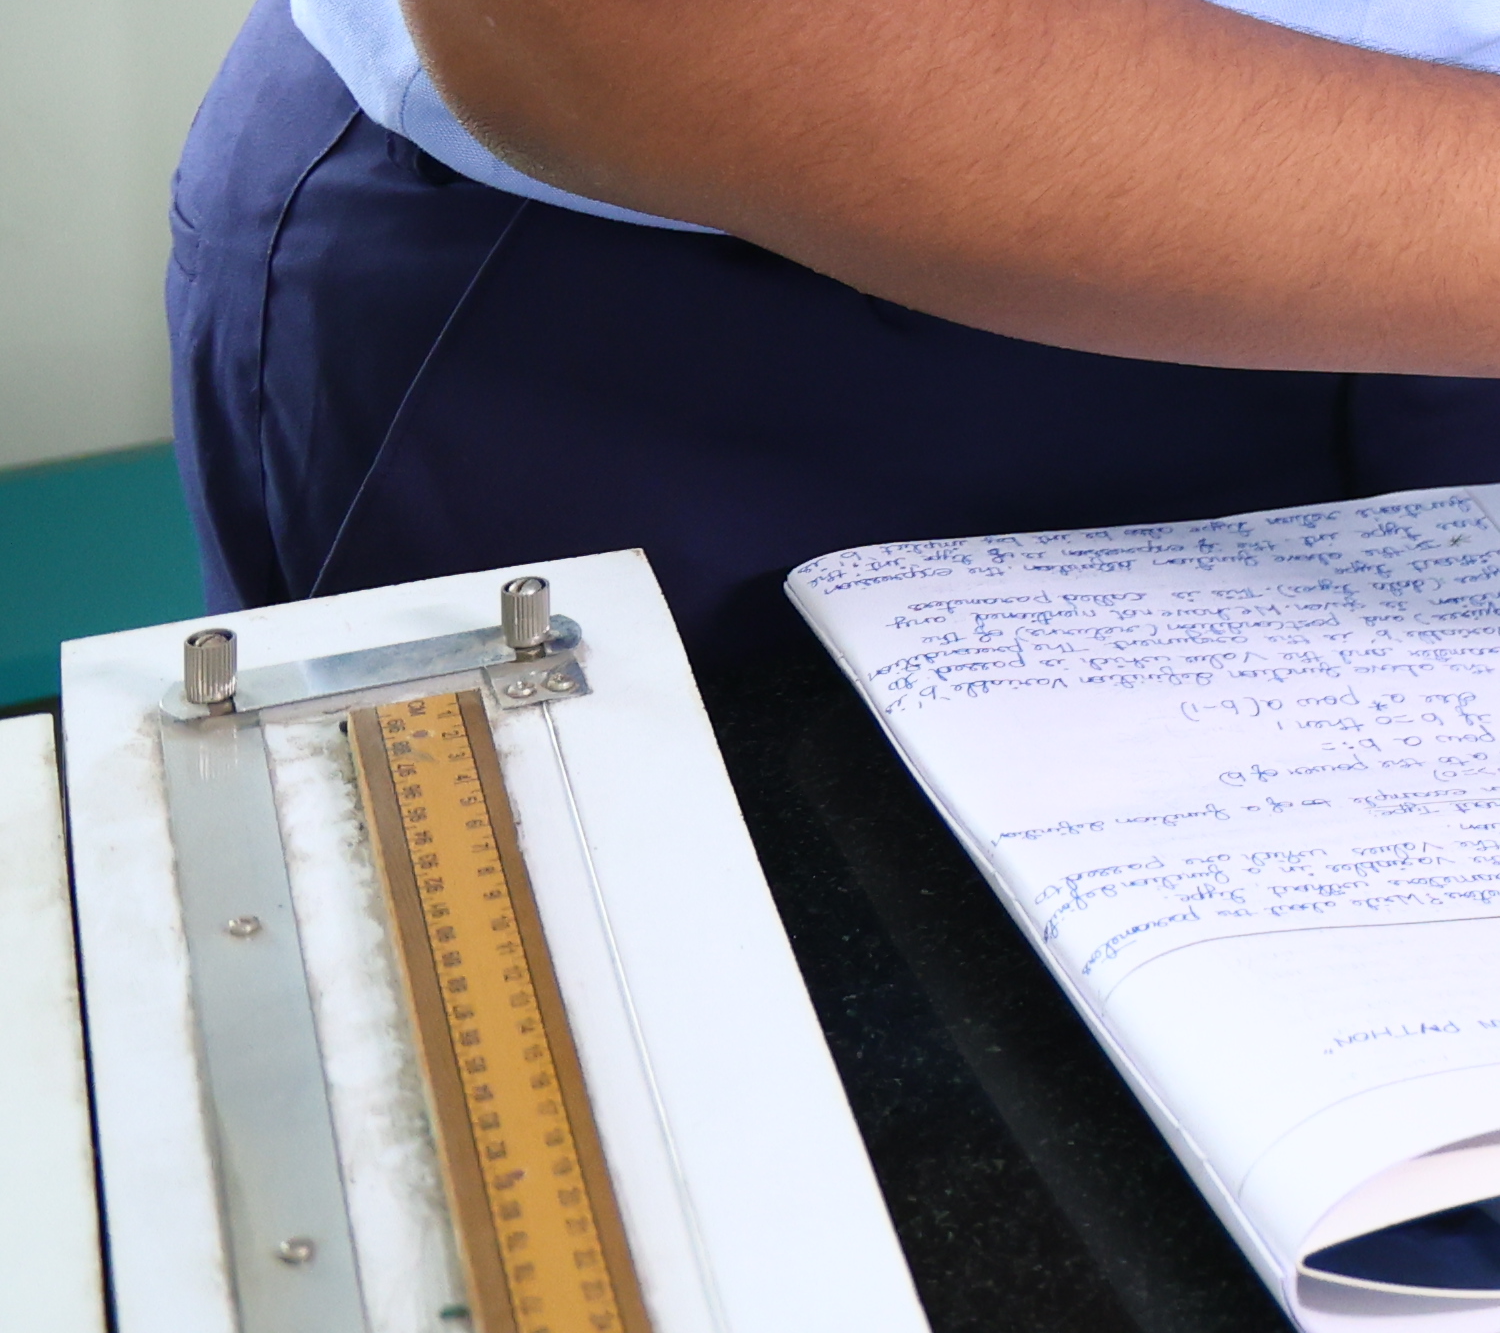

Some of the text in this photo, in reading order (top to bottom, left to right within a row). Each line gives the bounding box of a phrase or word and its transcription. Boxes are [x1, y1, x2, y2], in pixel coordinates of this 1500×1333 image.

[1056, 593, 1147, 604] called
[1157, 607, 1231, 620] have
[1358, 615, 1404, 627] and
[920, 632, 968, 645] the
[1263, 635, 1310, 648] the
[1277, 650, 1323, 664] the
[1332, 647, 1394, 664] and
[1038, 658, 1068, 671] is
[1080, 655, 1172, 670] which
[1227, 664, 1340, 683] function
[1446, 664, 1494, 676] the
[1295, 685, 1361, 708] pow
[1295, 716, 1365, 734] then
[1393, 735, 1422, 747] a
[1435, 725, 1496, 746] pow
[1378, 758, 1424, 767] the
[1250, 763, 1279, 783] of
[1264, 796, 1294, 814] of
[1114, 802, 1231, 827] function
[1453, 839, 1500, 853] the
[1181, 853, 1231, 865] are
[1216, 906, 1252, 918] the
